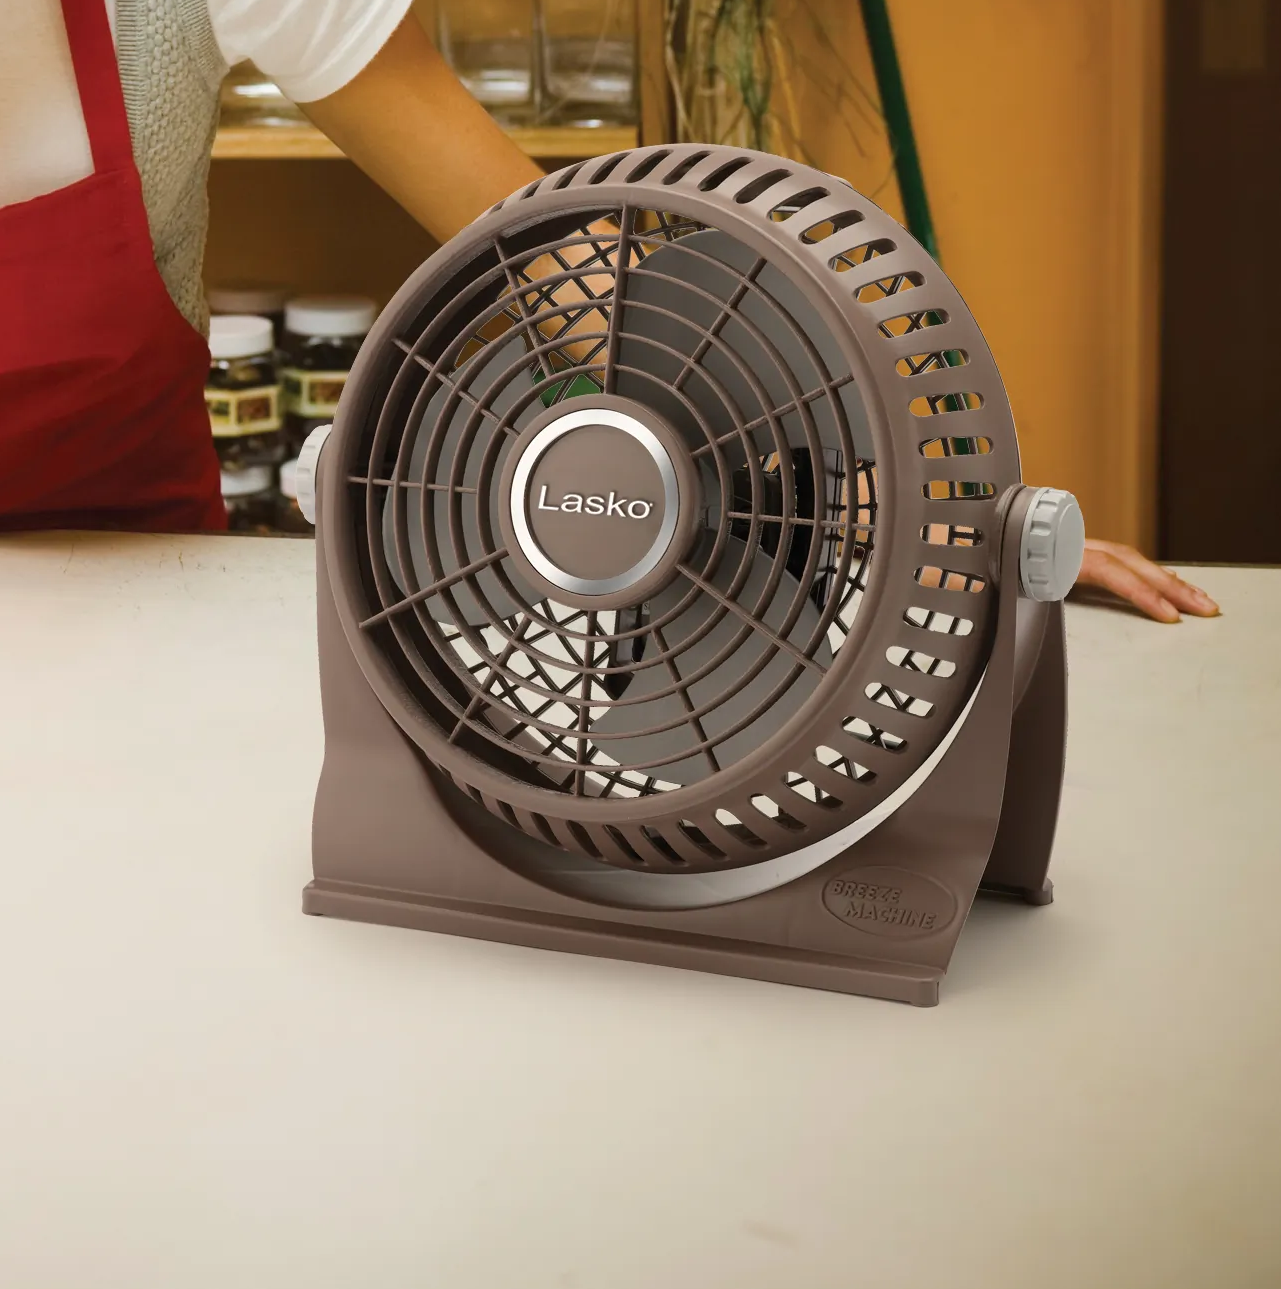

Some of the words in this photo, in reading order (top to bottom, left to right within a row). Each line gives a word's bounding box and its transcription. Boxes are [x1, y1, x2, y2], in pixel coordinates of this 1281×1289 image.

[537, 484, 652, 520] Lasko
[831, 879, 903, 904] BREEZE
[845, 901, 937, 929] MACHINE
